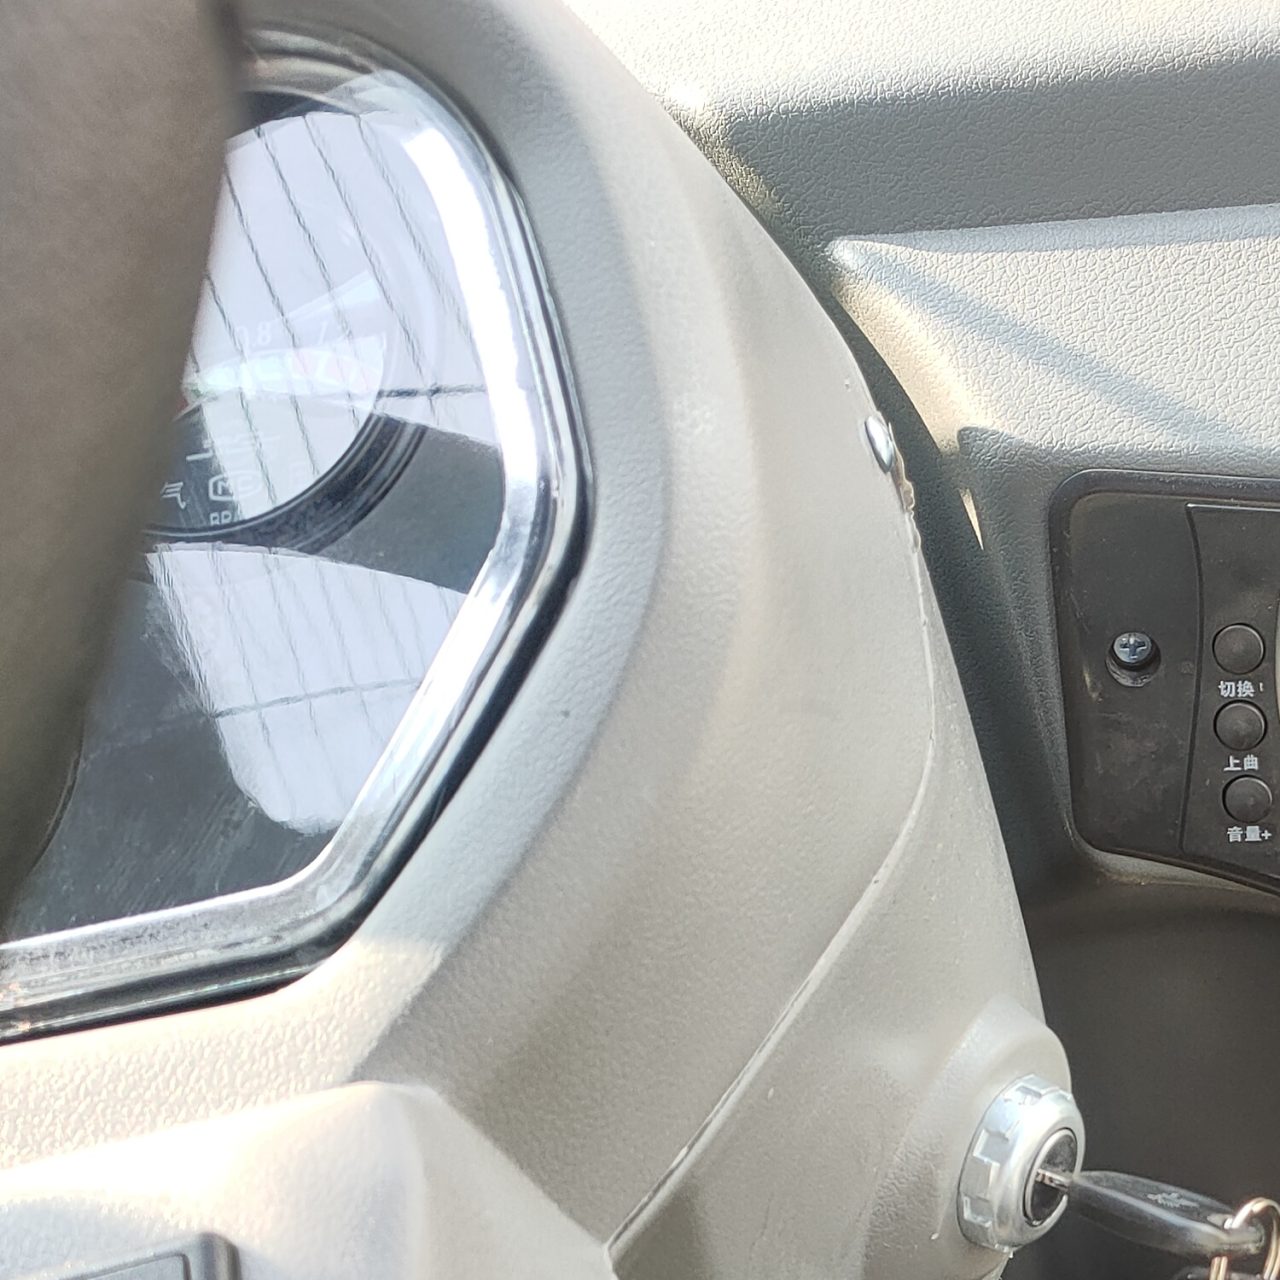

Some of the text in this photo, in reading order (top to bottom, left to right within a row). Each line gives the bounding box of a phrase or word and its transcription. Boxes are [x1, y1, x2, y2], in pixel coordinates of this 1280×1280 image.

[1218, 680, 1255, 697] 切换
[1223, 754, 1259, 772] 上曲
[1226, 825, 1272, 843] 音量+
